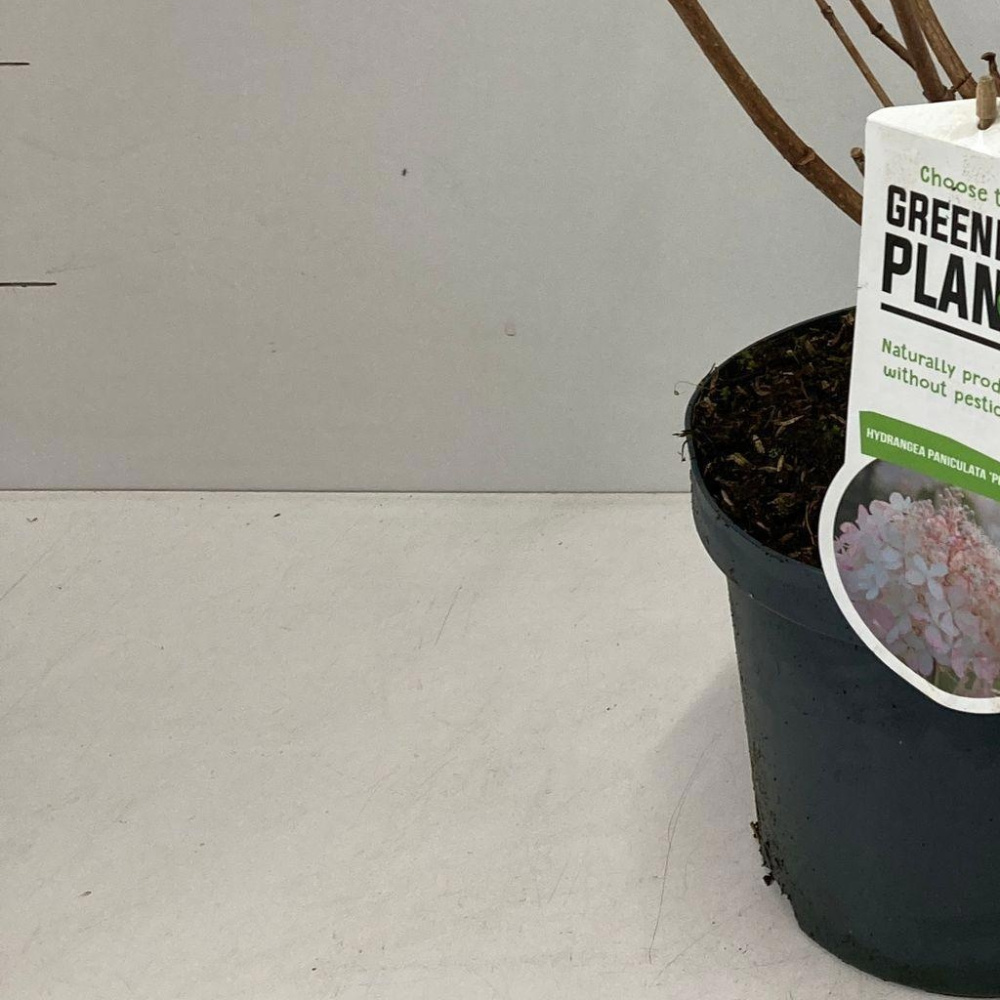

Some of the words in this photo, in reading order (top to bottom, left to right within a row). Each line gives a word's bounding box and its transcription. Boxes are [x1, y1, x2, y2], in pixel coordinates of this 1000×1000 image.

[920, 165, 988, 202] Choose
[881, 338, 956, 379] Naturally
[883, 365, 948, 397] without
[866, 427, 926, 457] HYDRANGEA
[927, 449, 986, 480] PANICULATA
